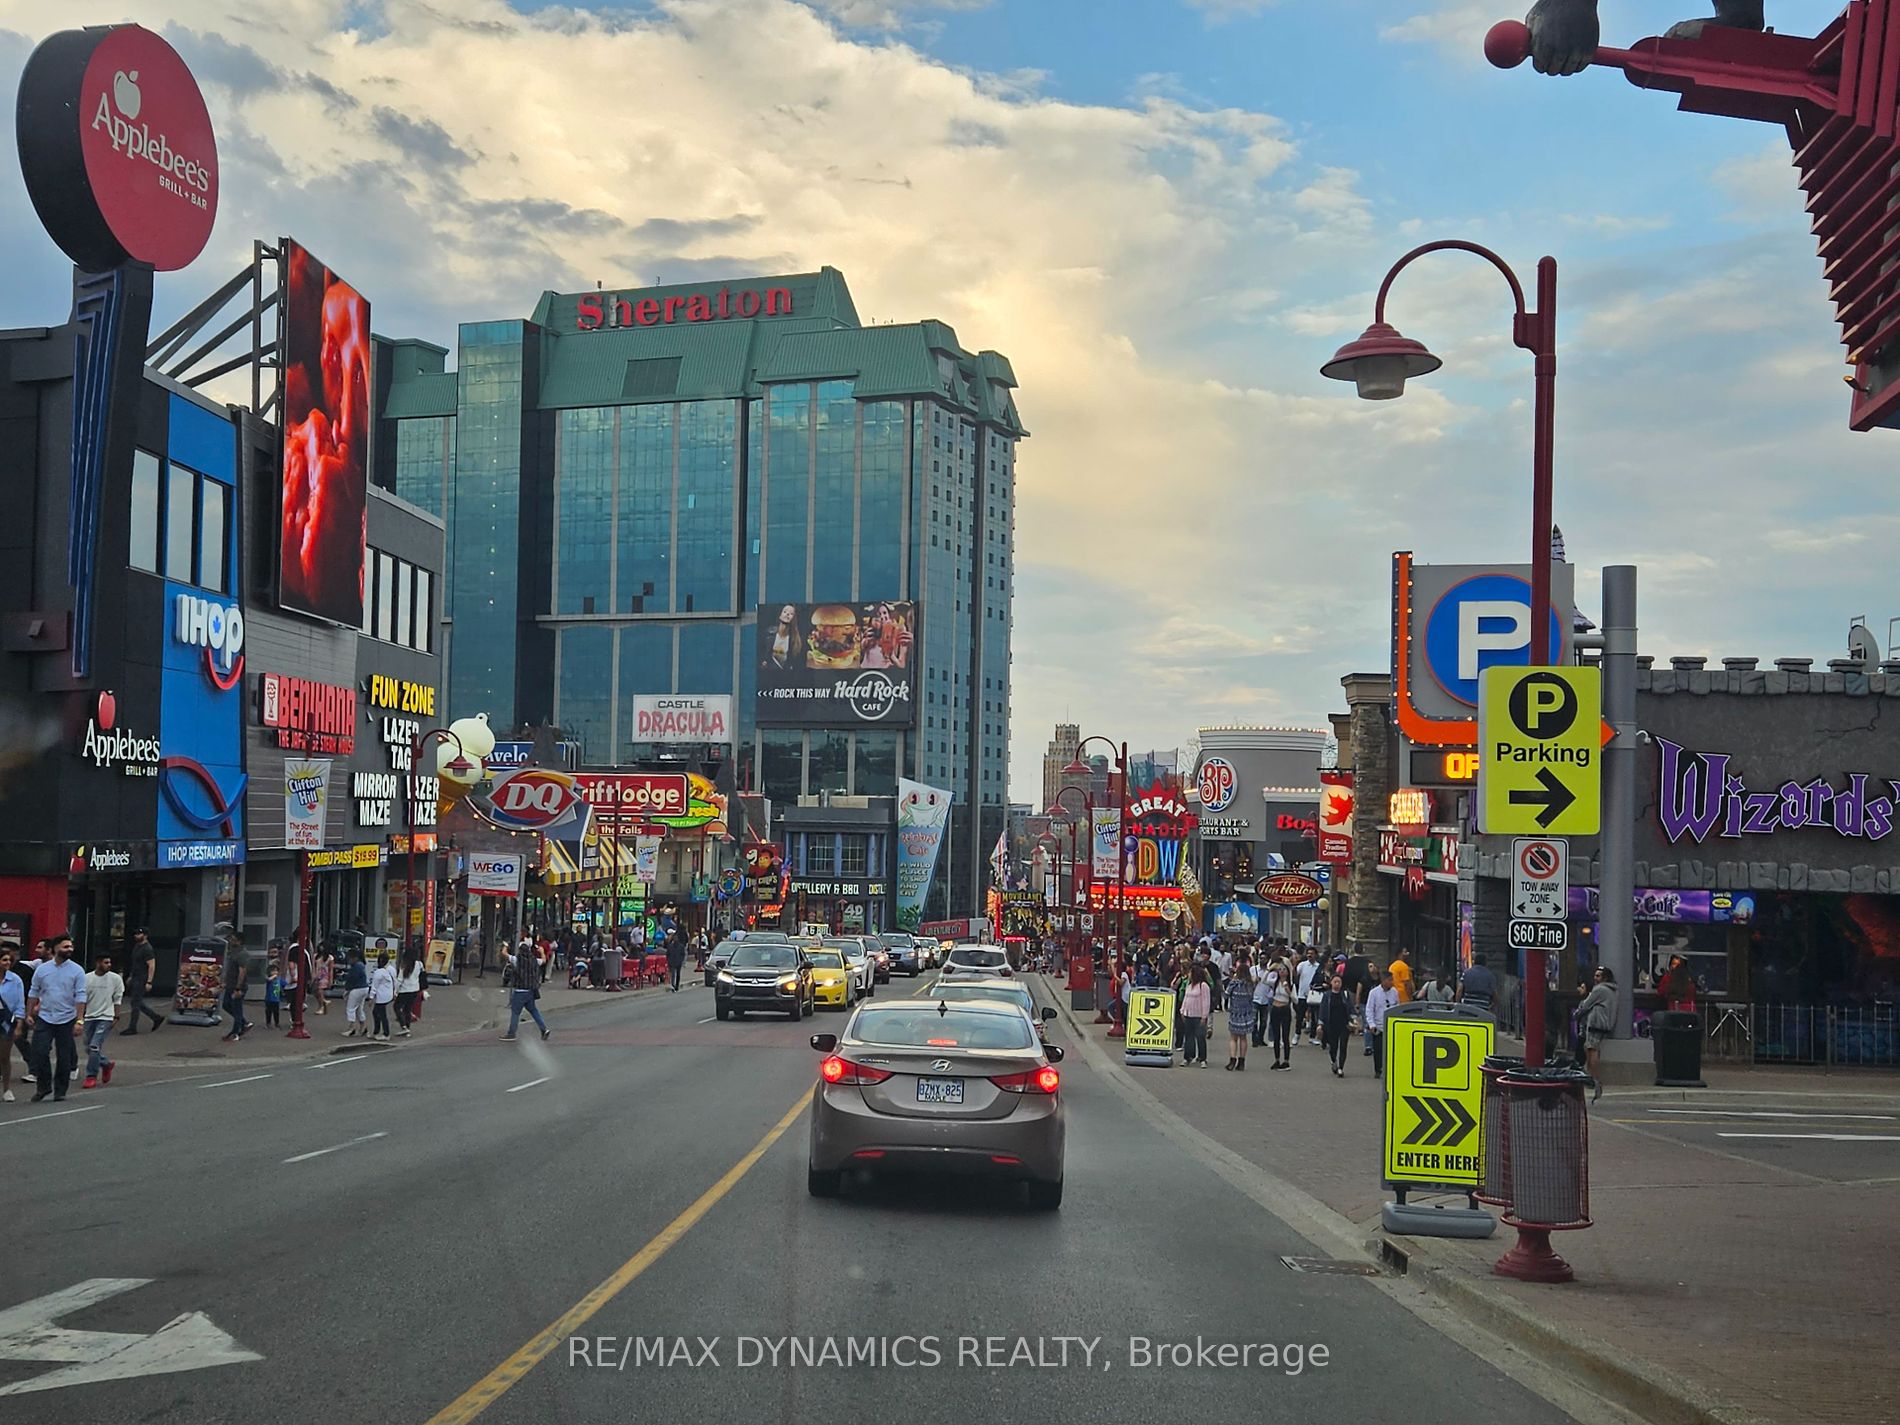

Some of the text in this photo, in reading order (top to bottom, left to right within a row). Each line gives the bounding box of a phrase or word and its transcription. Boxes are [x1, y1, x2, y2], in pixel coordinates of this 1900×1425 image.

[92, 93, 209, 193] Applebee's
[159, 175, 184, 198] GRILL
[191, 193, 208, 211] BAR
[577, 287, 793, 330] Sheraton
[1458, 601, 1532, 680] P
[371, 674, 436, 716] FUN ZONE
[774, 688, 831, 699] ROCK THIS WAY
[833, 681, 909, 702] Hard Rock
[658, 700, 704, 709] CASTLE
[1527, 683, 1566, 729] P
[383, 716, 420, 747] LAZER
[638, 710, 725, 738] DRACULA
[82, 718, 160, 767] Applebee's
[1497, 743, 1590, 767] Parking
[126, 765, 158, 776] GRILL BAR
[288, 776, 323, 793] Clifton
[354, 772, 396, 799] MIRROR
[1200, 762, 1233, 804] BP
[299, 789, 319, 805] Hill
[504, 783, 563, 815] DQ
[1130, 797, 1186, 817] GREAT
[360, 800, 391, 826] MAZE
[1241, 818, 1249, 827] &
[290, 822, 319, 831] The Street
[620, 826, 642, 834] Falls
[1221, 827, 1240, 836] BAR
[306, 838, 319, 846] Falls
[90, 847, 130, 870] Applebee's
[168, 845, 237, 862] IHOP RESTAURANT
[333, 850, 352, 865] PASS
[354, 848, 377, 863] $19.99
[473, 862, 514, 874] WEGO
[791, 883, 860, 895] DISTILLERY & BBQ
[1260, 881, 1320, 895] Tim Hortons
[1521, 882, 1560, 892] TOW AWAY
[1530, 894, 1550, 904] ZONE
[1513, 924, 1562, 945] $60 Fine
[1144, 998, 1161, 1014] P
[1422, 1036, 1461, 1084] P
[1397, 1152, 1481, 1172] ENTER HERE
